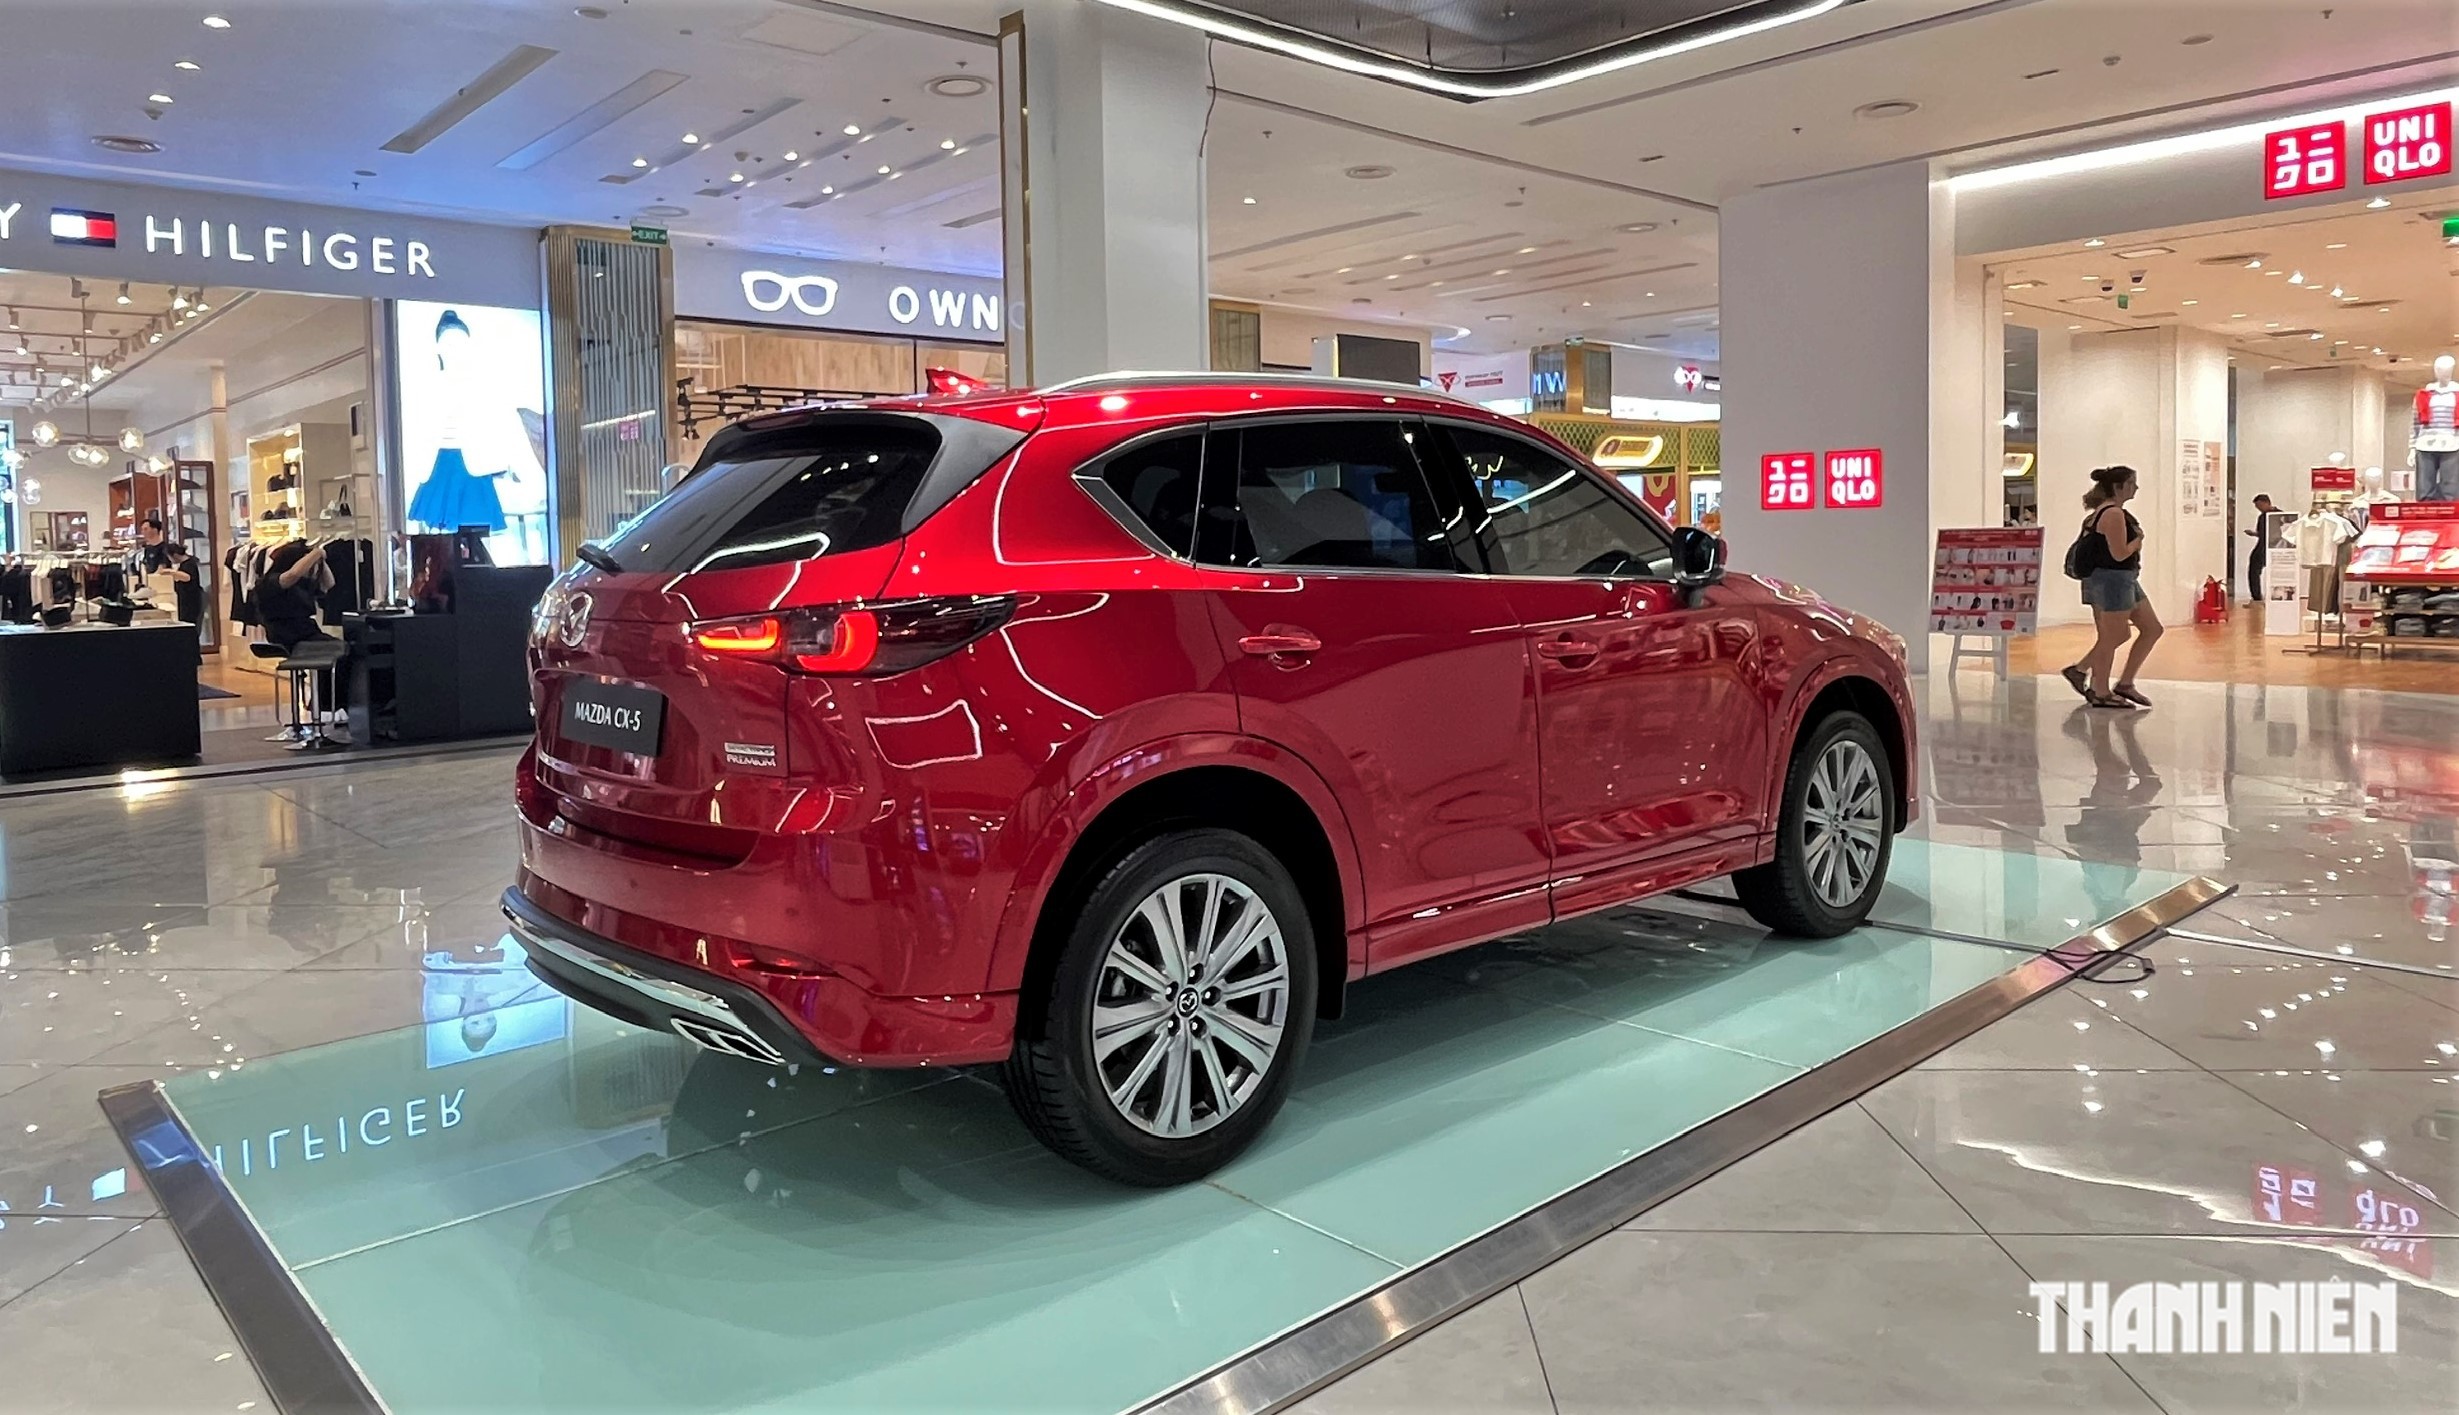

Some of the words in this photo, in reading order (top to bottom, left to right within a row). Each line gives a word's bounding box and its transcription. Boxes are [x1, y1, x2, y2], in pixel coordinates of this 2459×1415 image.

[2374, 113, 2435, 147] UNI
[2276, 131, 2335, 163] ユニ
[2374, 142, 2441, 177] QLO
[145, 214, 436, 279] HILFIGER
[639, 230, 659, 240] EXIT
[1769, 460, 1808, 481] ユニ
[1832, 457, 1871, 479] UNI
[1832, 479, 1876, 505] QLO
[575, 702, 612, 726] MAZDA
[614, 707, 642, 732] CX-5
